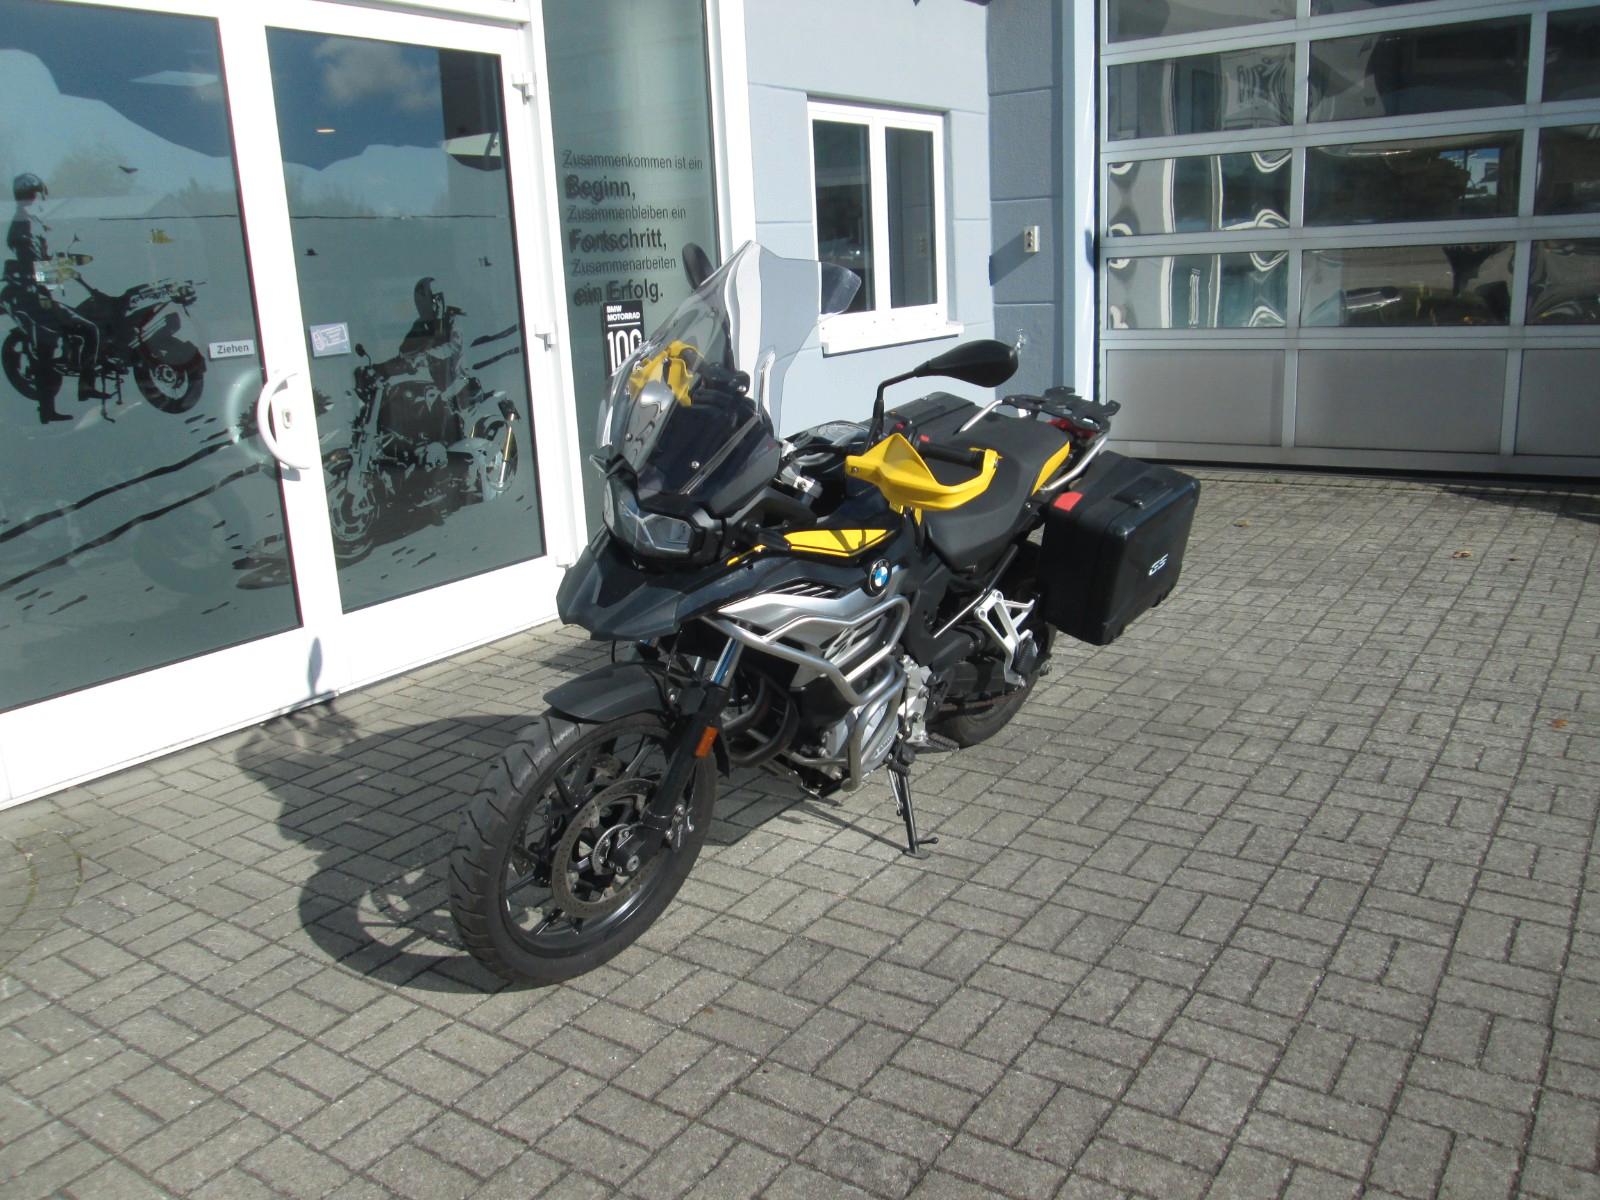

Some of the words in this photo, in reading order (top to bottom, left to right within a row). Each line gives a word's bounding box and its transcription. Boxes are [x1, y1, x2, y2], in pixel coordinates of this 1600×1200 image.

[563, 150, 672, 169] Zusammenkommen
[675, 158, 686, 169] ist
[688, 158, 703, 170] ein
[565, 174, 636, 203] Beginn,
[567, 205, 669, 223] Zusammenbleiben
[671, 207, 686, 220] ein
[569, 228, 667, 252] Fortschritt,
[572, 256, 677, 276] Zusammenarbeiten
[574, 282, 603, 305] ein
[606, 279, 664, 303] Erfolg.
[606, 305, 622, 313] BMW
[607, 312, 641, 321] MOTORRAD
[217, 344, 249, 354] Ziehen
